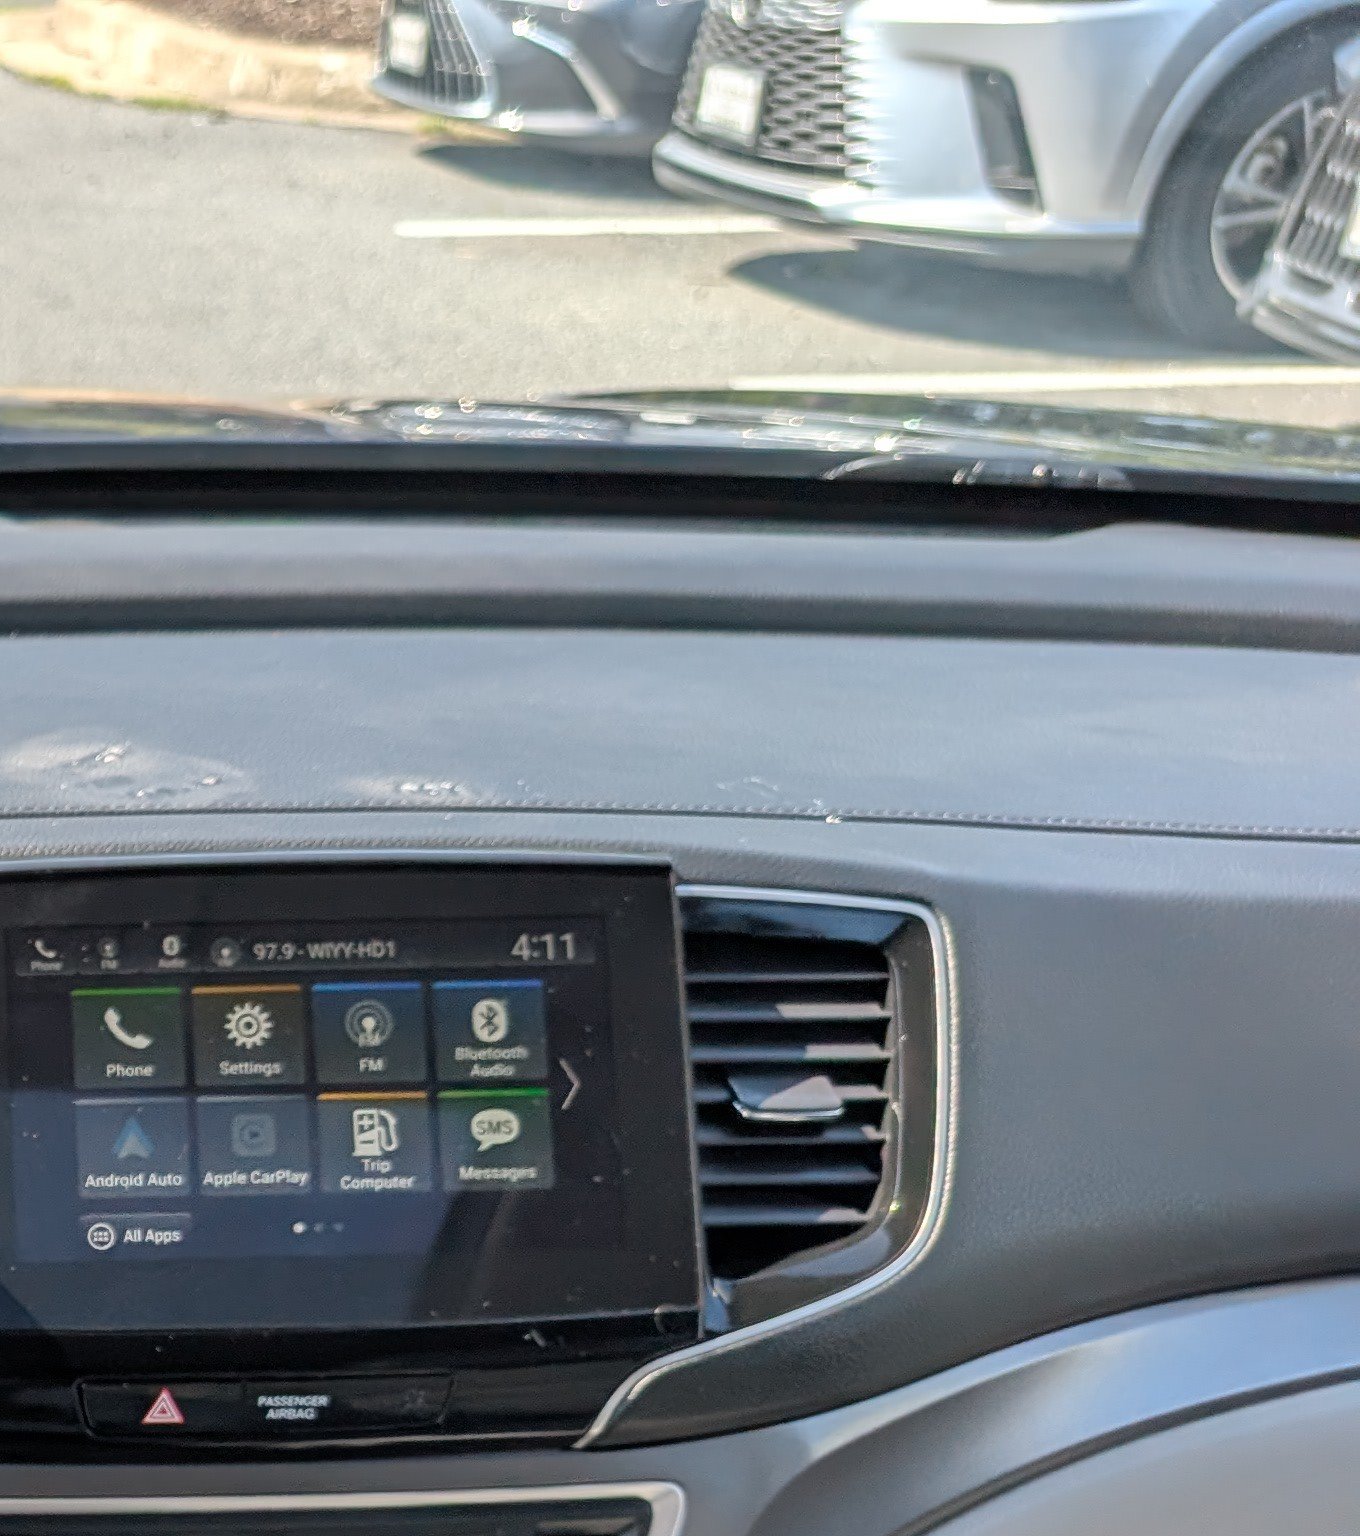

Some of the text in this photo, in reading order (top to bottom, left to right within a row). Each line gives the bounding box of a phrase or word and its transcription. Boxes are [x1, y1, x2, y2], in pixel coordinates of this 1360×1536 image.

[252, 942, 296, 961] 97.9
[512, 931, 576, 962] 4:11
[454, 1046, 530, 1061] Bluetooth
[106, 1063, 154, 1078] Phone
[219, 1060, 283, 1077] Settings
[359, 1058, 385, 1073] FM
[470, 1063, 515, 1078] Audio
[475, 1119, 514, 1136] SMS
[361, 1158, 392, 1174] Trip
[459, 1166, 538, 1182] Messages
[84, 1172, 184, 1189] Android Auto
[202, 1169, 310, 1187] Apple CarPlay
[340, 1175, 416, 1191] Computer
[123, 1229, 182, 1244] All Apps
[257, 1395, 330, 1407] PASSENGER
[266, 1408, 318, 1420] AIRBAG
